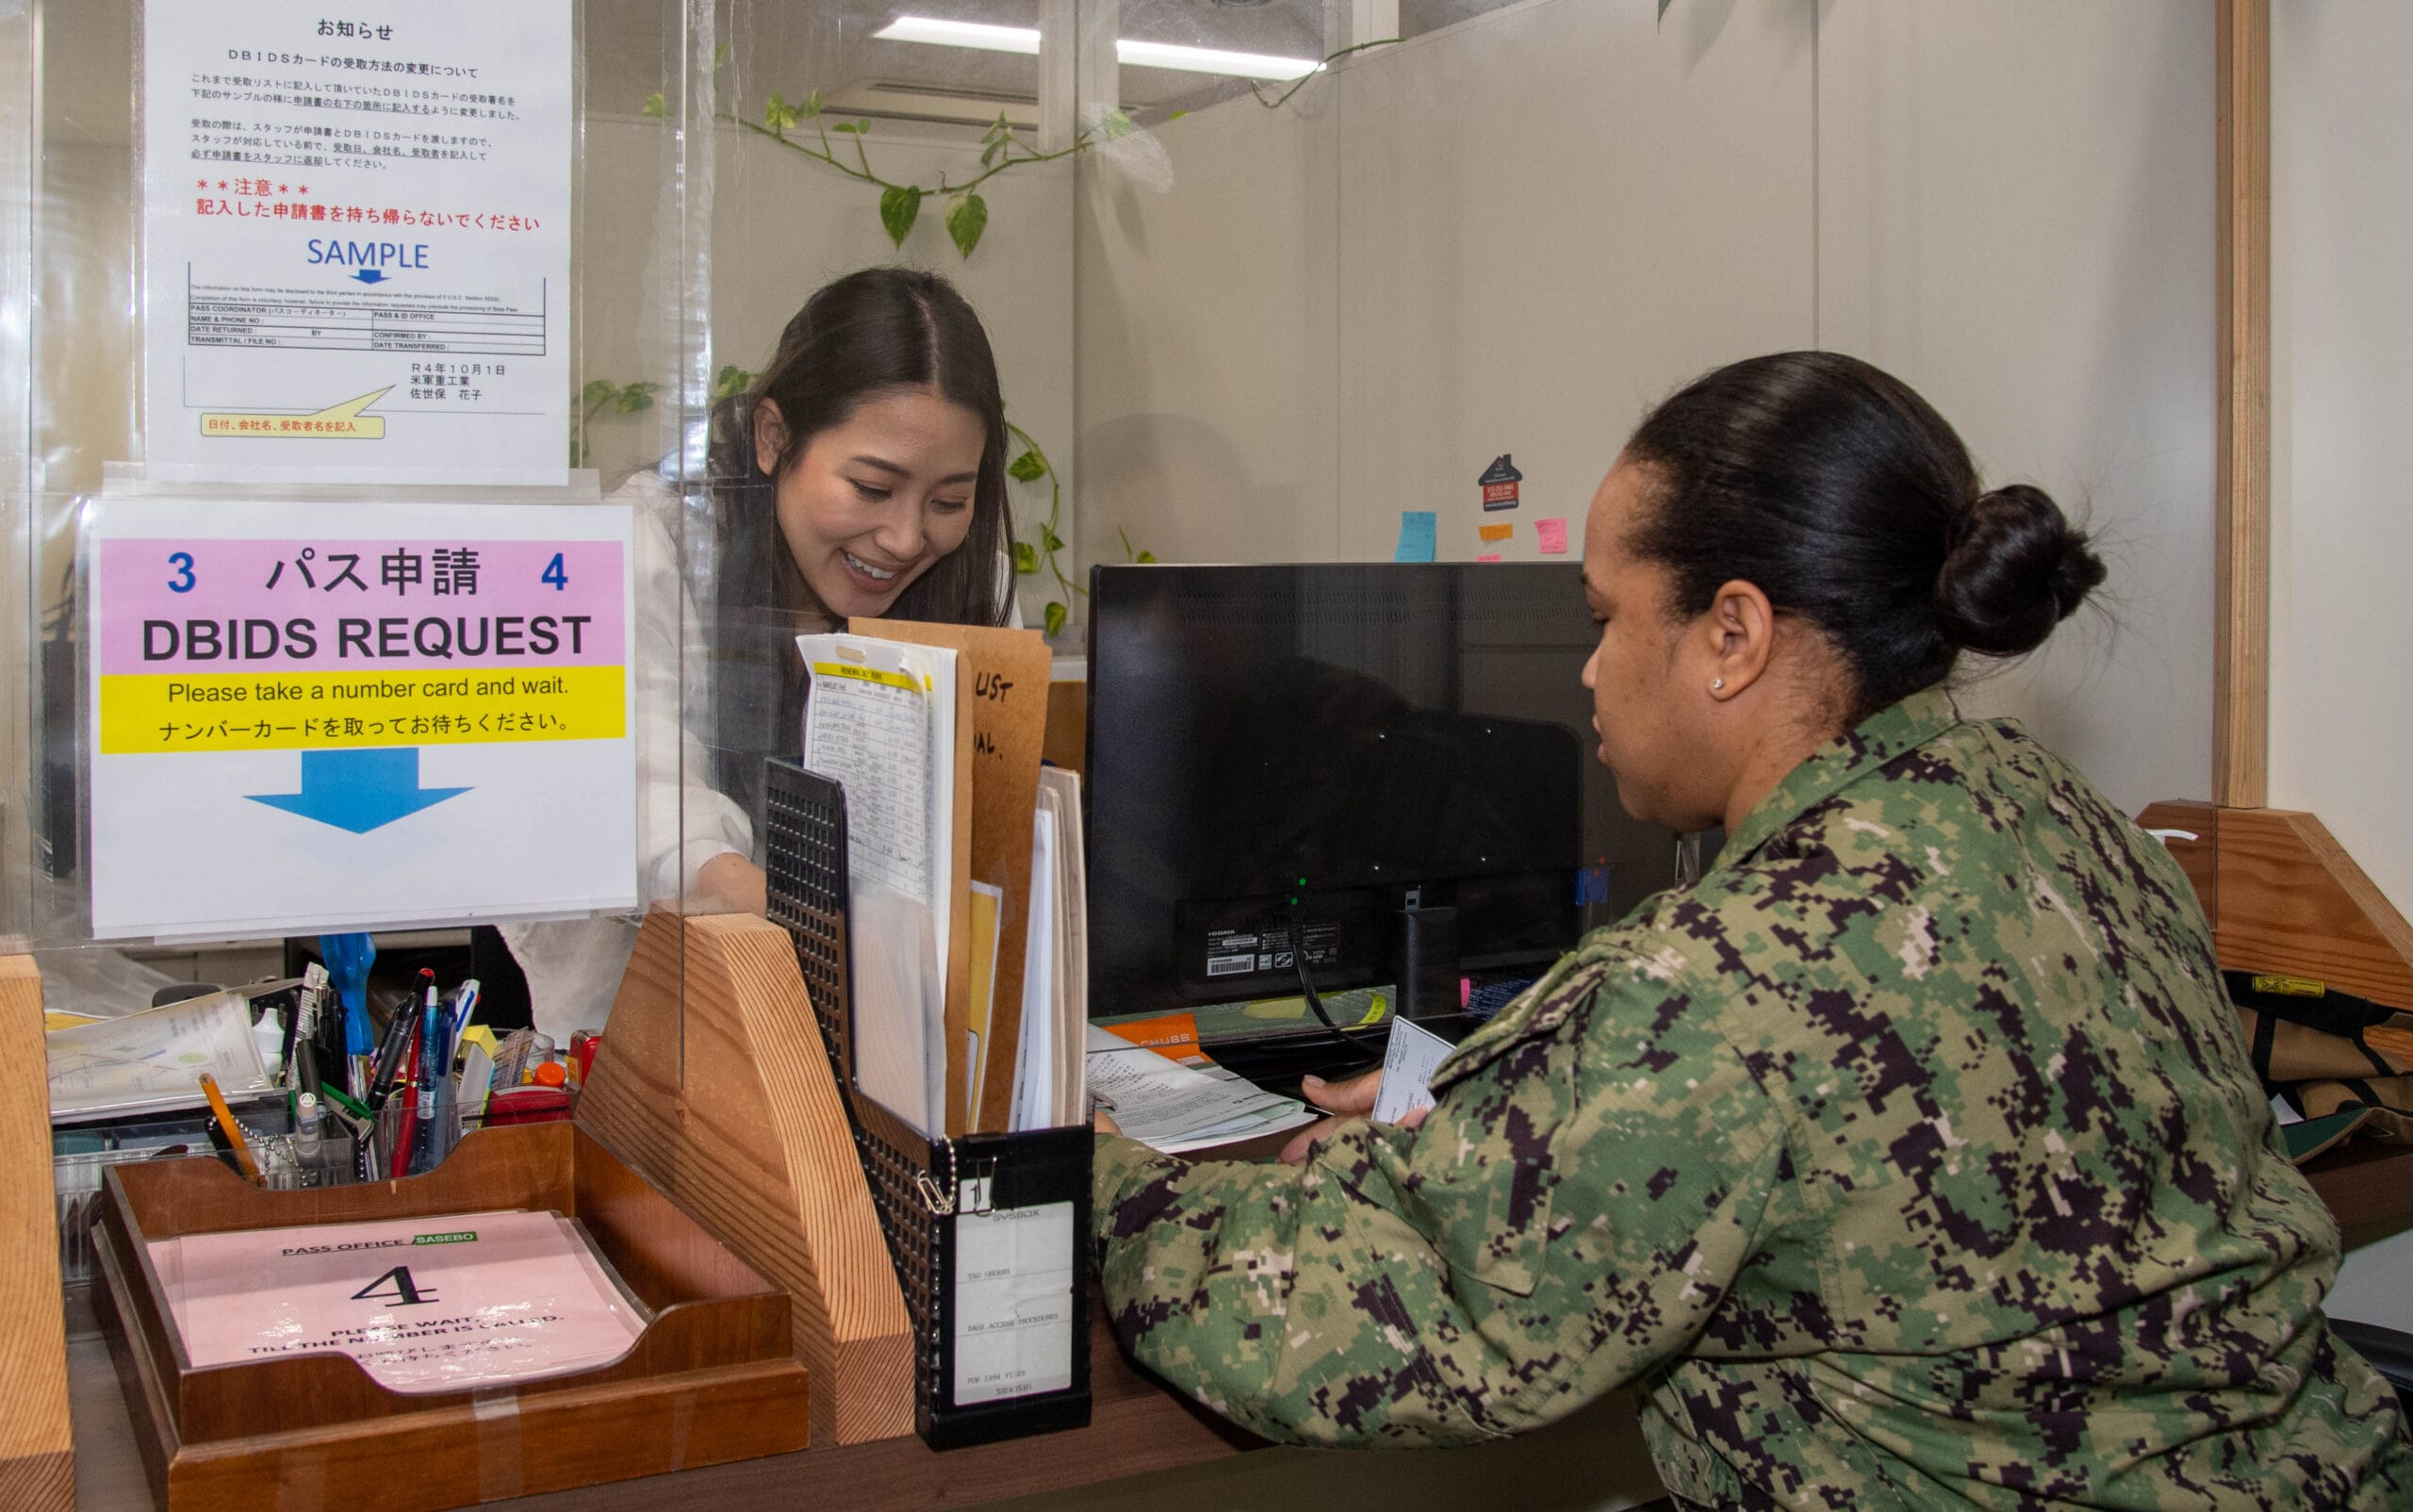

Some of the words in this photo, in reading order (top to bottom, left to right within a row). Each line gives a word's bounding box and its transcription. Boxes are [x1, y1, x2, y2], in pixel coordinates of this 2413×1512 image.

[318, 19, 393, 41] お知らせ
[196, 198, 540, 232] 記入した申請書を持ち帰らないでください
[307, 239, 430, 270] SAMPLE
[410, 375, 470, 386] 米軍重工業
[410, 388, 447, 400] 佐世保
[459, 389, 483, 400] 花子
[208, 419, 356, 433] 日付、会社名、受取者名を記入
[168, 552, 196, 594] 3
[266, 548, 481, 596] パス申請
[541, 552, 568, 591] 4
[143, 618, 318, 662] DBIDS
[337, 616, 592, 660] REQUEST
[168, 682, 248, 703] Please
[254, 681, 304, 702] take
[310, 684, 324, 700] a
[332, 679, 415, 700] number
[422, 678, 469, 698] card
[476, 677, 515, 697] and
[521, 676, 569, 696] wait.
[159, 712, 568, 743] ナンバーカードを取ってお待ちください。
[993, 1208, 1041, 1222] SYSBOX
[283, 1244, 331, 1256] PASS
[337, 1240, 404, 1251] OFFICE
[416, 1233, 474, 1244] SASEBO
[351, 1266, 439, 1307] 4
[298, 1339, 341, 1349] THE
[454, 1326, 474, 1335] IS
